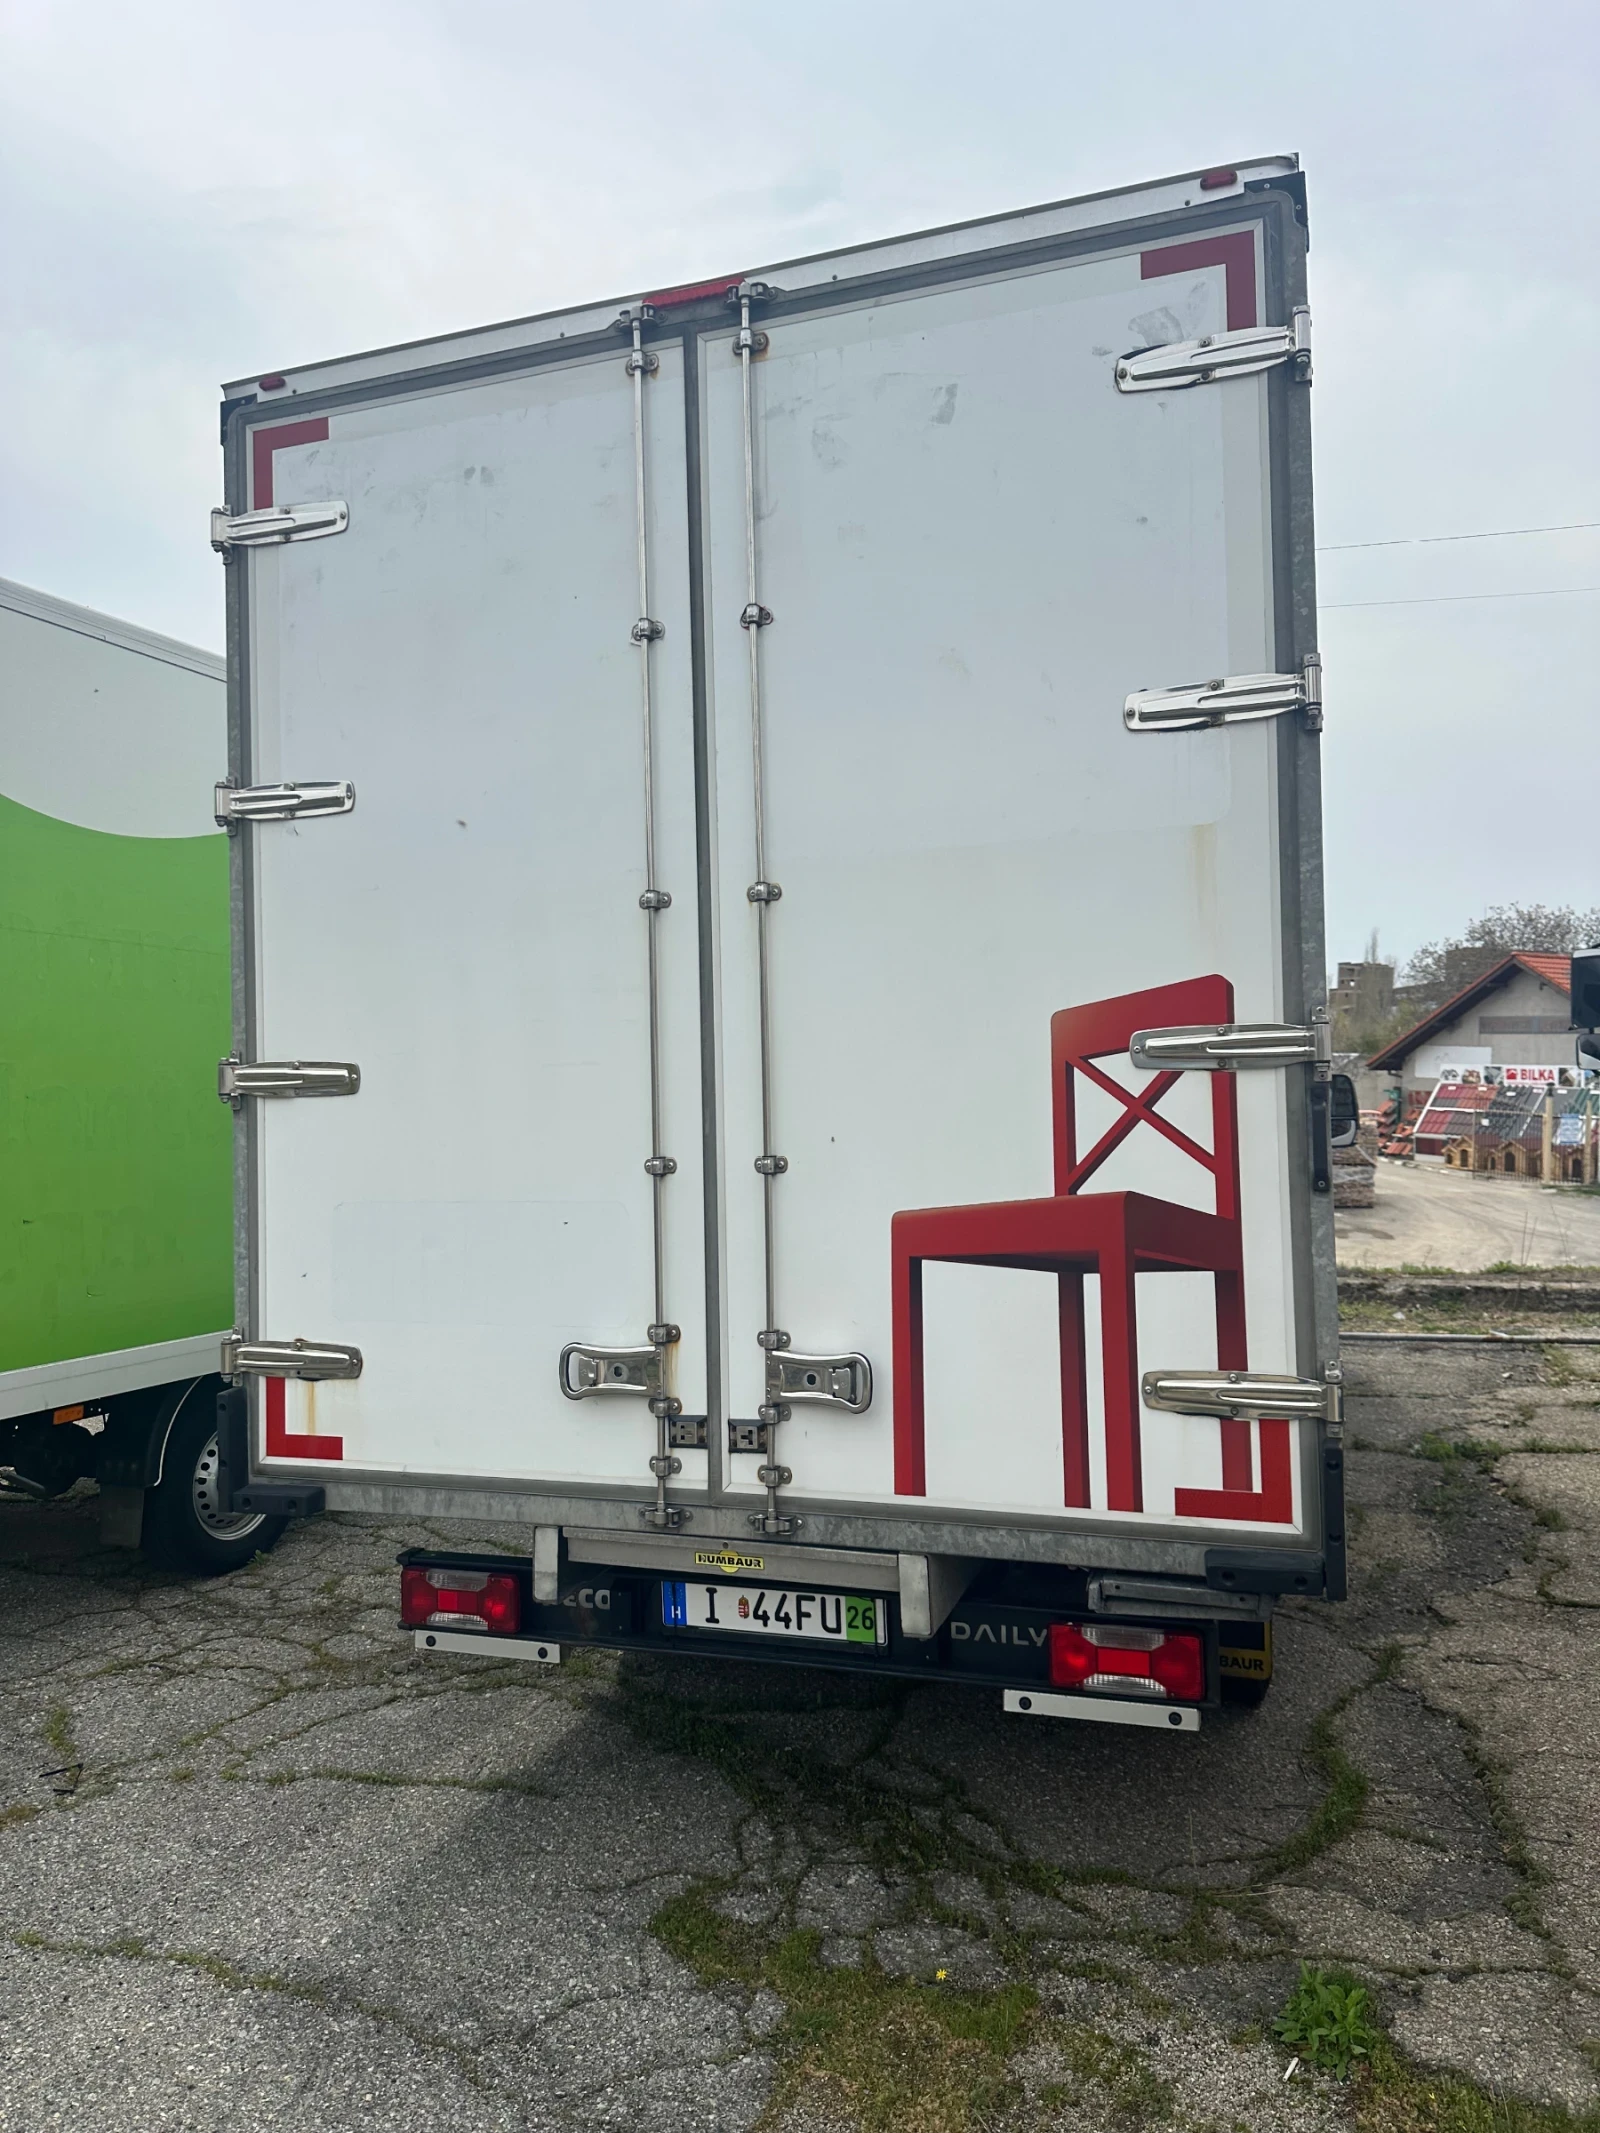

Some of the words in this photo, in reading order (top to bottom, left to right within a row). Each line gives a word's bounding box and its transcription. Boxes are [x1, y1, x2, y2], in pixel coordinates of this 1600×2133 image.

[1520, 1068, 1555, 1081] BILKA
[698, 1554, 761, 1568] HUMBAUR
[671, 1605, 681, 1619] H
[705, 1586, 720, 1624] I
[847, 1605, 875, 1631] 26
[950, 1621, 1048, 1647] DAILY
[1219, 1655, 1265, 1672] BAUR
